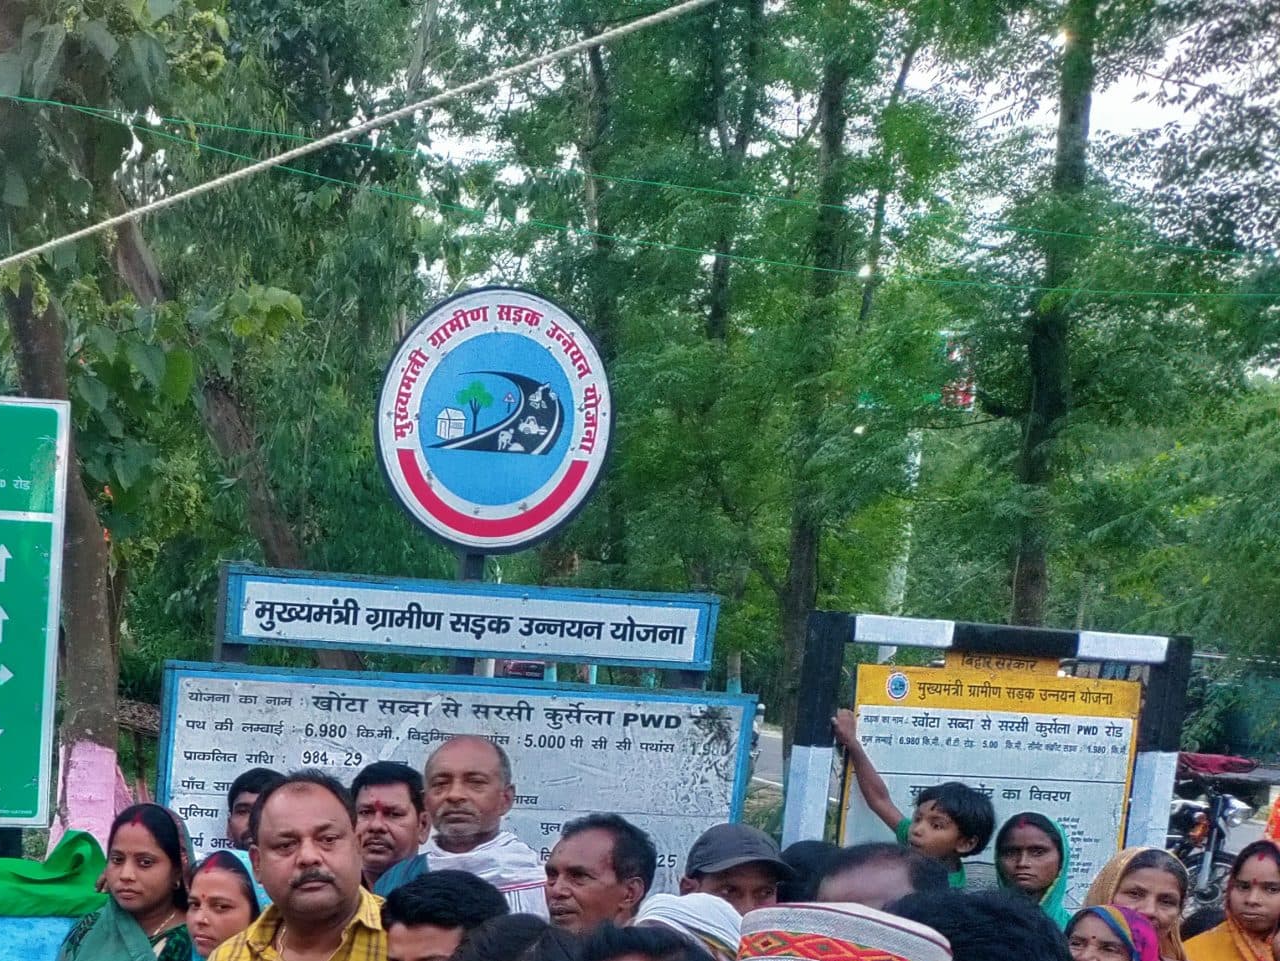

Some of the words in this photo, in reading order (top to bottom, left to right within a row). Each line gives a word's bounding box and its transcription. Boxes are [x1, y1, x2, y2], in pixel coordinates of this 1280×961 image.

[427, 306, 489, 349] ग्रामीण
[497, 304, 543, 327] सड़क
[580, 384, 602, 454] योजना
[255, 598, 360, 631] मुख्यमंत्री
[365, 602, 444, 631] ग्रामीण
[450, 612, 513, 640] सड़क
[518, 616, 605, 640] उन्नयन
[610, 616, 687, 645] योजना
[995, 657, 1039, 673] सरकार
[917, 679, 963, 700] मुख्यमंत्री
[967, 680, 1001, 699] ग्रामीण
[1006, 687, 1035, 703] सड़क
[1038, 688, 1076, 703] उन्नयन
[1080, 688, 1113, 705] योजना
[188, 688, 231, 704] योजना
[238, 694, 258, 705] का
[265, 696, 292, 708] नाम
[311, 691, 369, 714] खोंटा
[378, 698, 432, 718] सब्दा
[442, 697, 462, 719] से
[472, 700, 535, 722] सरसी
[543, 702, 615, 730] कुर्सेला
[622, 712, 682, 729] PWD
[186, 720, 207, 732] पथ
[214, 718, 233, 732] की
[242, 720, 284, 737] लम्बाई
[304, 723, 348, 739] 6.980
[524, 734, 566, 749] 5.000
[570, 736, 583, 748] पी
[591, 736, 607, 750] सी
[616, 737, 631, 751] सी
[640, 740, 674, 754] पथांस
[980, 715, 992, 731] से
[998, 716, 1029, 732] सरसी
[1077, 725, 1098, 736] PWD
[1105, 721, 1123, 737] रोड
[899, 736, 920, 746] 6.980
[982, 740, 998, 749] 5.00
[1087, 745, 1106, 754] 1.980
[183, 749, 237, 764] प्राकलित
[245, 751, 274, 764] राशि
[181, 776, 205, 791] पाँच
[1002, 788, 1021, 800] का
[1029, 785, 1071, 802] विवरण
[179, 804, 219, 819] पुलिया
